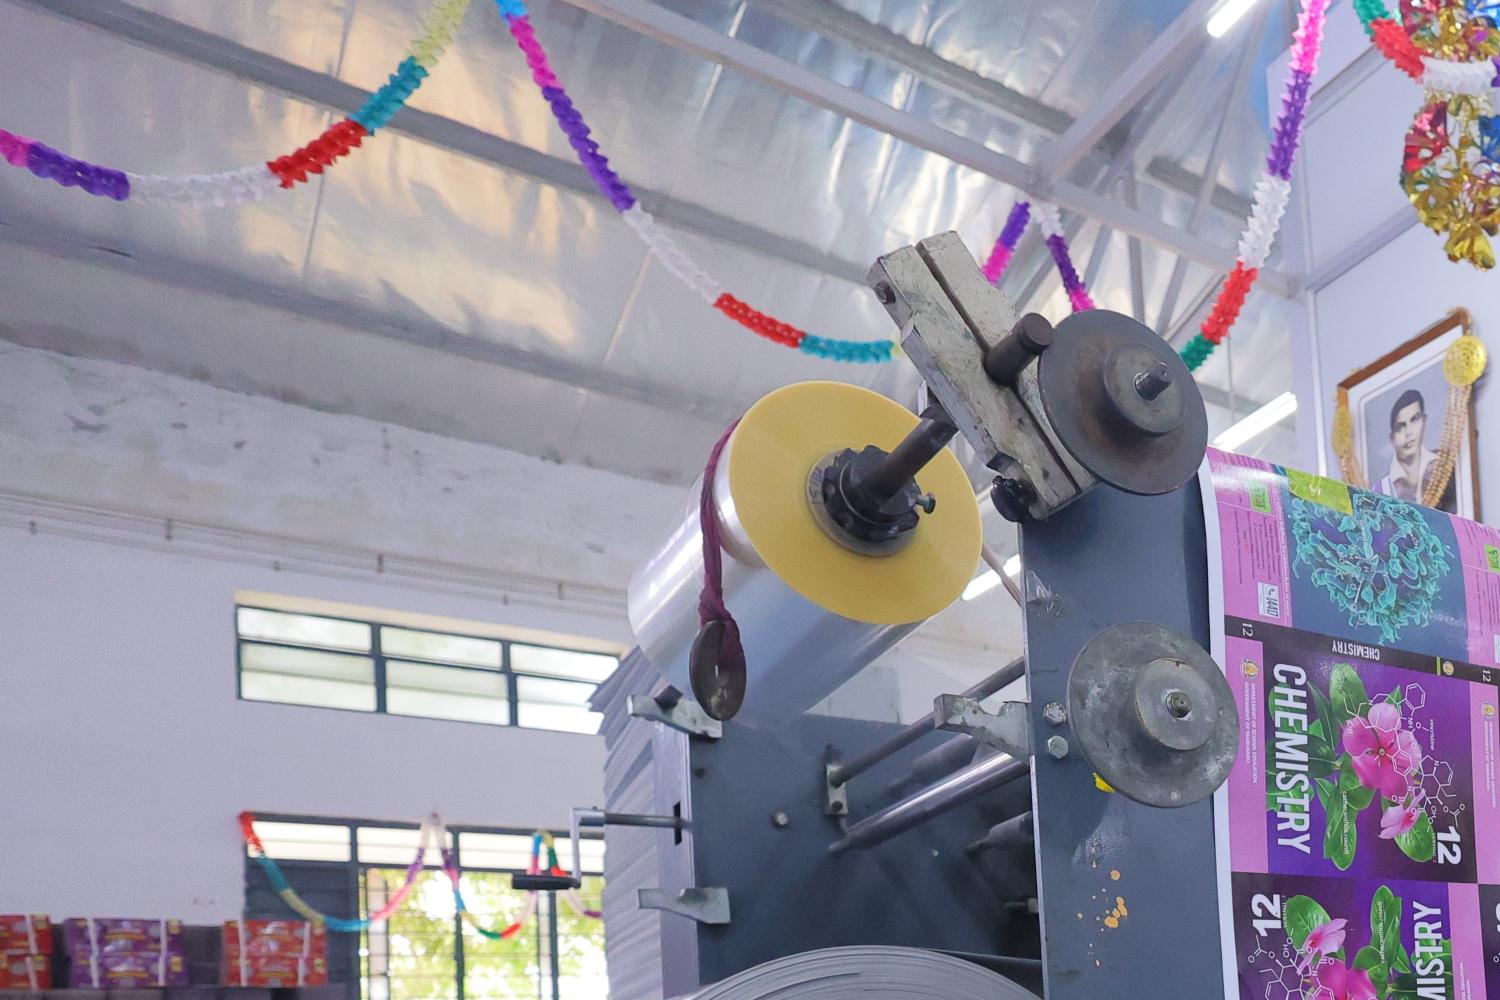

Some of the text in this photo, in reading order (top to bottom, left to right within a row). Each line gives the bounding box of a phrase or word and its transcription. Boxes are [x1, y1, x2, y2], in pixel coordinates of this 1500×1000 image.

[1241, 622, 1253, 637] 12
[1332, 640, 1380, 661] CHEMISTRY
[1482, 669, 1492, 682] 12
[1273, 663, 1311, 855] CHEMISTRY
[1437, 826, 1462, 865] 12
[1251, 893, 1282, 937] 12
